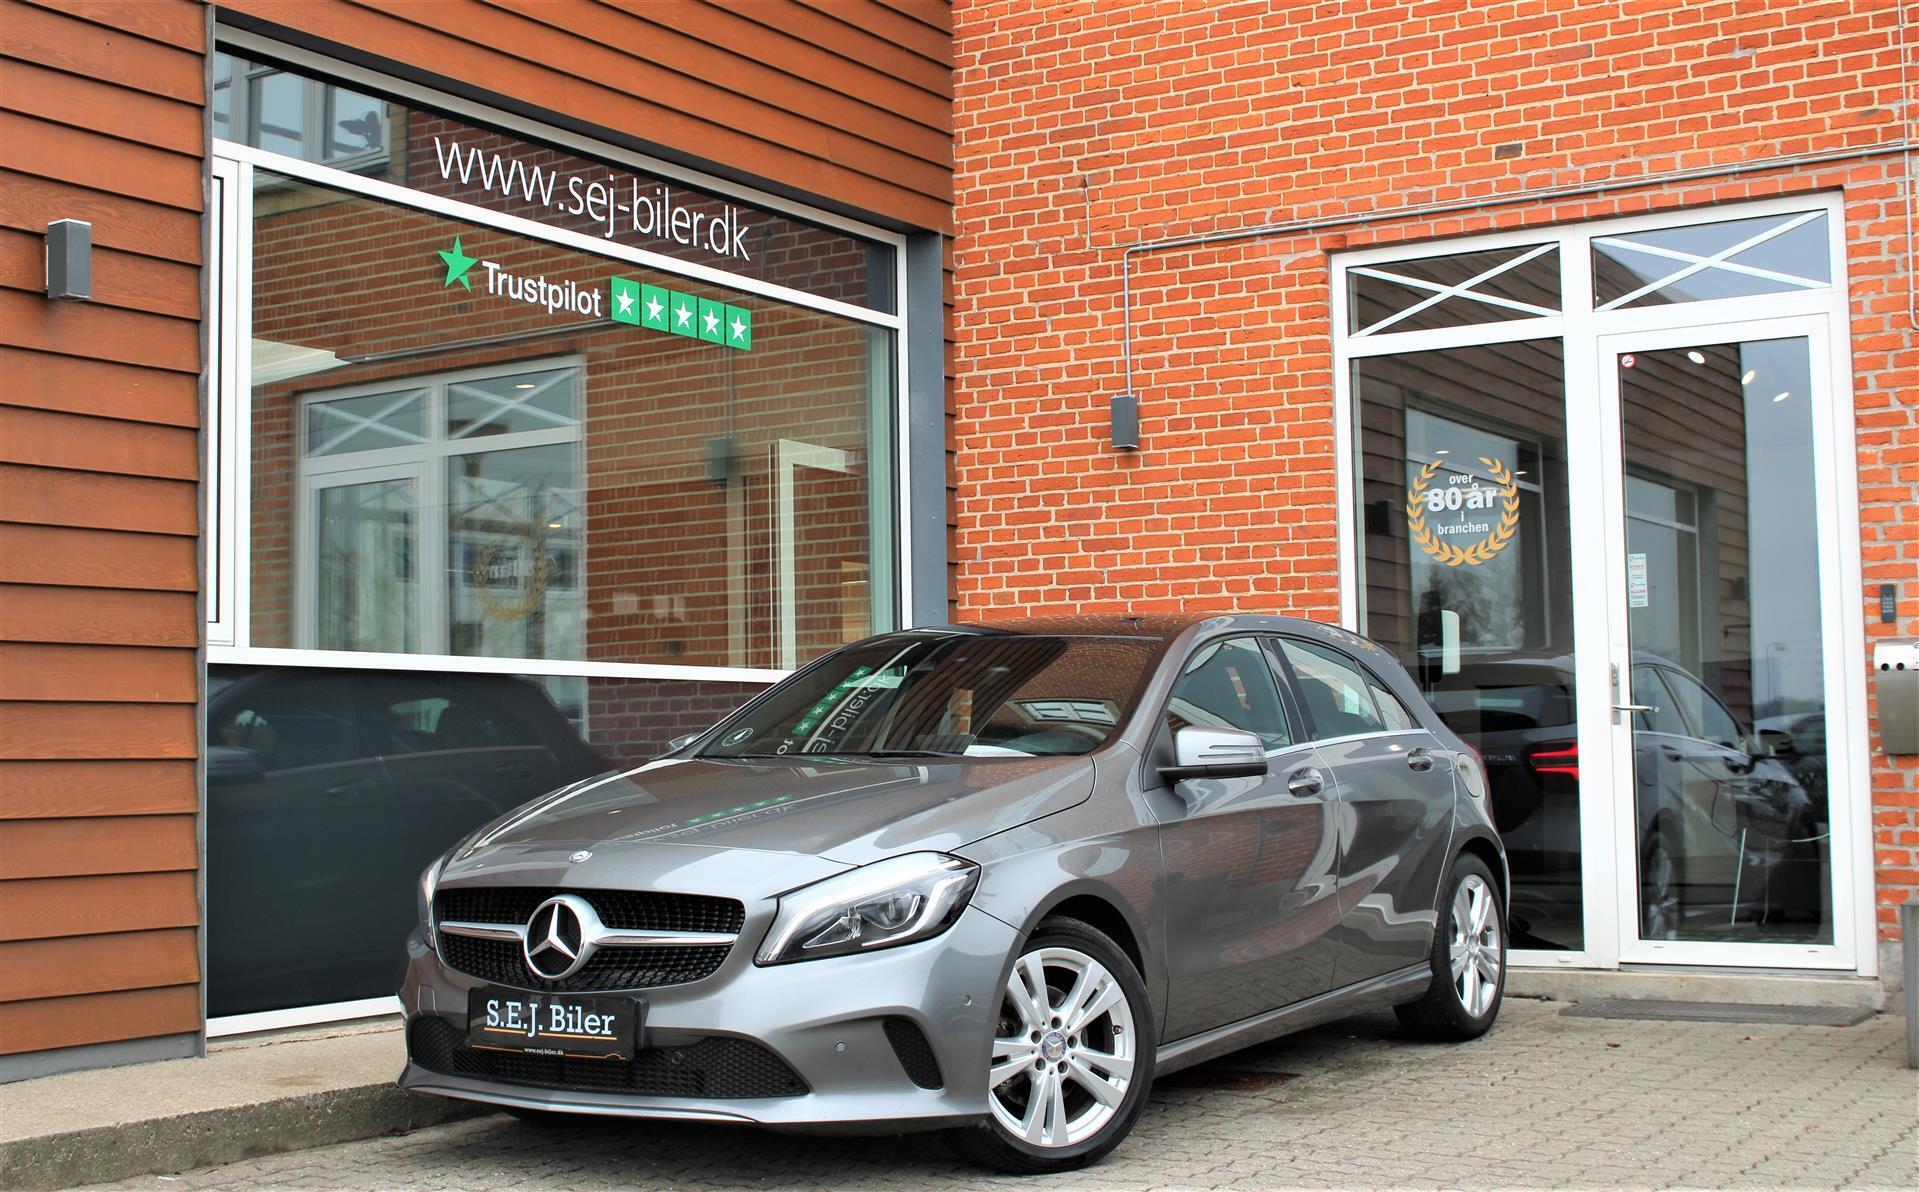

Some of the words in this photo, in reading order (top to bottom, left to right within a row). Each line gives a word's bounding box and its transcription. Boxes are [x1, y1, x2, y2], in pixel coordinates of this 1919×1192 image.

[434, 136, 750, 262] www.sej-biler.dk
[482, 260, 602, 318] Trustpilot
[1449, 474, 1474, 484] over
[1427, 486, 1463, 512] 80
[1466, 483, 1497, 509] år
[1438, 522, 1489, 534] branchen
[1460, 511, 1465, 522] i
[486, 1000, 544, 1038] S.E.J.
[549, 1004, 616, 1036] Biler
